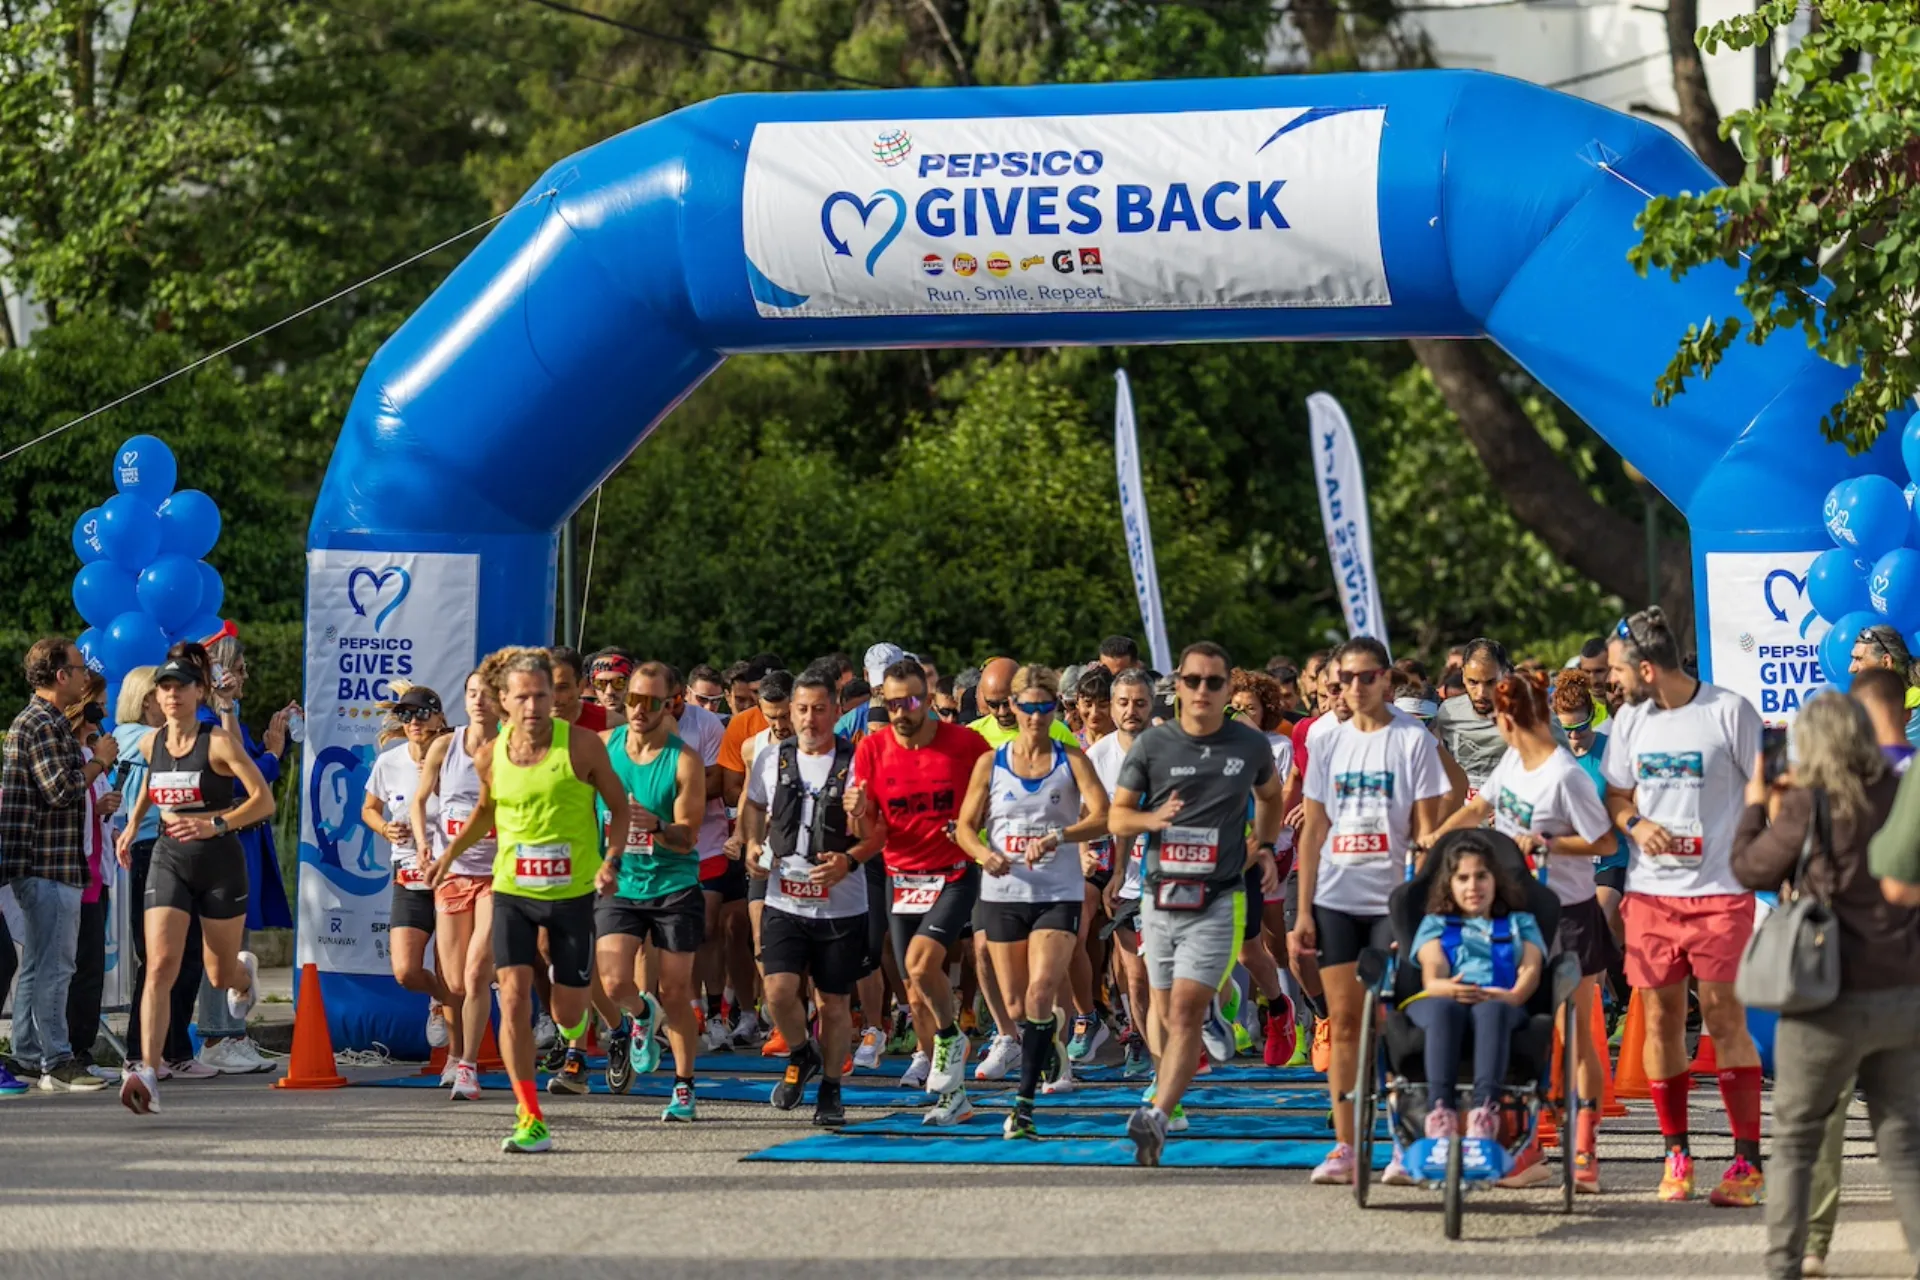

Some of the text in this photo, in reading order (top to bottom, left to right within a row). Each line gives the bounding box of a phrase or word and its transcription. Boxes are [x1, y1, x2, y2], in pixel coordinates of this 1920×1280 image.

[918, 149, 1104, 178] PEPSICO
[915, 180, 1291, 237] GIVES BACK
[927, 284, 1111, 303] Run. Smile. Repeat.
[339, 637, 413, 651] PEPSICO
[1758, 645, 1819, 658] PEPSI
[338, 653, 413, 675] GIVES
[1760, 661, 1826, 685] GIVE
[1761, 687, 1818, 713] BA
[153, 789, 195, 804] 1235
[1336, 835, 1381, 852] 1253
[1165, 846, 1211, 860] 1058
[522, 860, 566, 875] 1114
[784, 881, 823, 897] 1249
[318, 935, 357, 946] RUNAWAY
